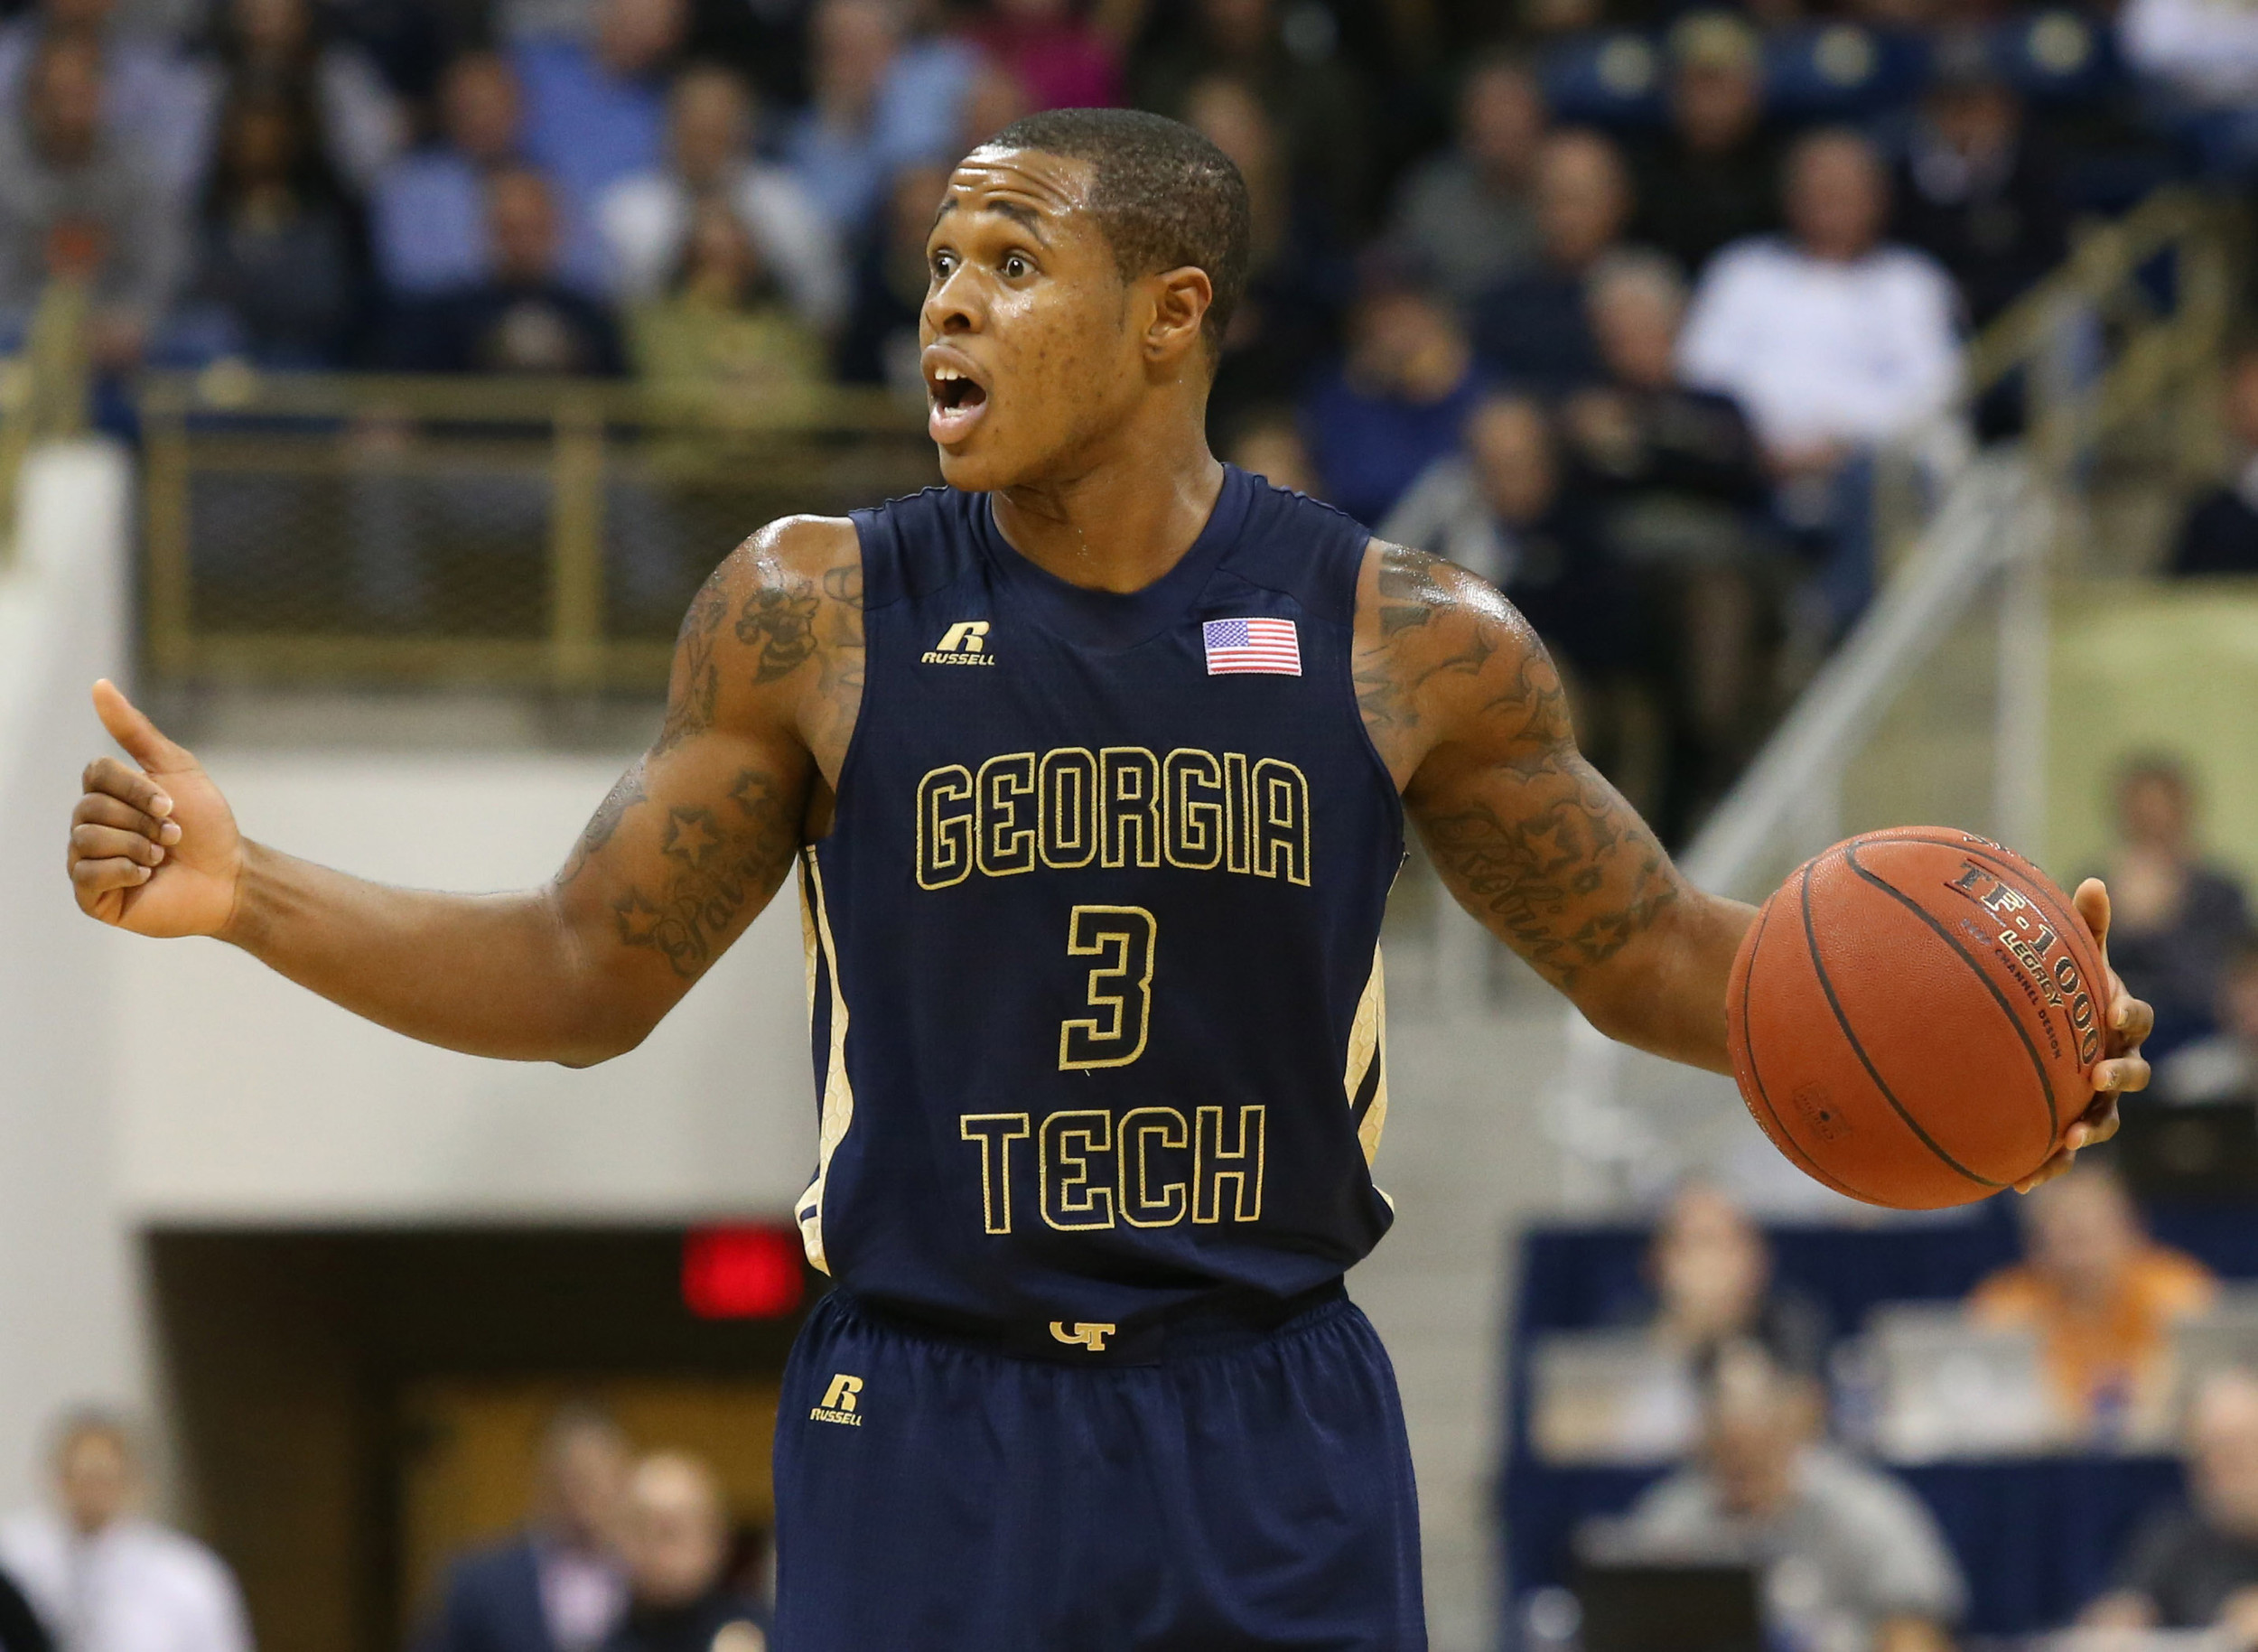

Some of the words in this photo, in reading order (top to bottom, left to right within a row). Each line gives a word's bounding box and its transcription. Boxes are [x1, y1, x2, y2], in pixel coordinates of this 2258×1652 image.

[920, 651, 995, 666] RUSSELL
[916, 746, 1311, 891] GEORGIA
[1059, 905, 1157, 1071] 3
[1953, 860, 2098, 1067] TF-1000
[1994, 948, 2039, 1006] CHANNEL
[2038, 1009, 2061, 1059] DESIGN
[1999, 929, 2064, 1007] LEGACY
[960, 1105, 1265, 1235] TECH
[809, 1407, 862, 1427] RUSSELL
